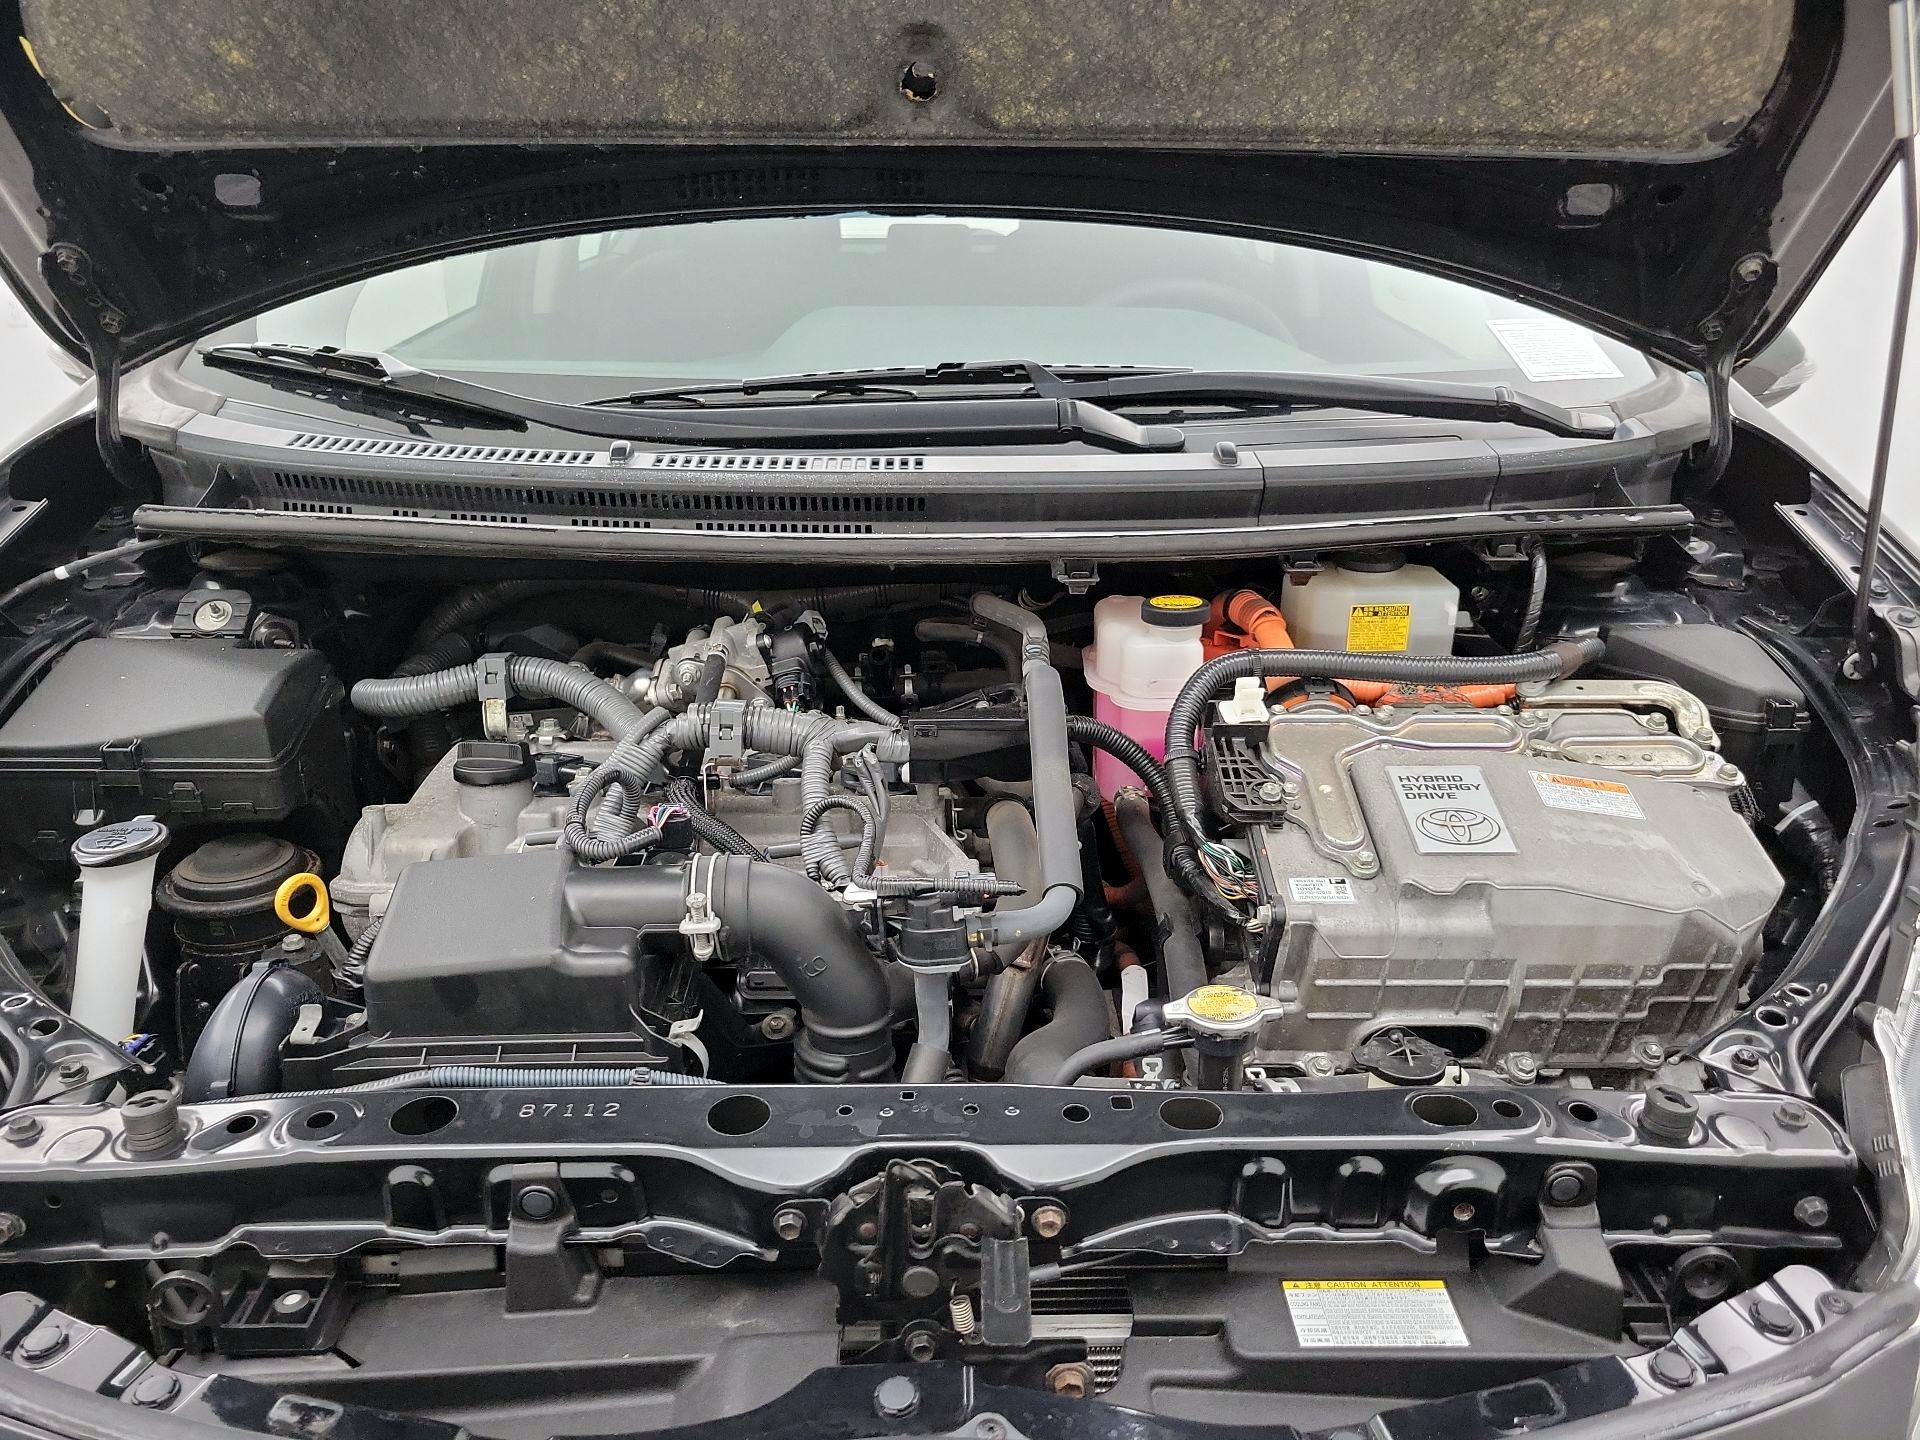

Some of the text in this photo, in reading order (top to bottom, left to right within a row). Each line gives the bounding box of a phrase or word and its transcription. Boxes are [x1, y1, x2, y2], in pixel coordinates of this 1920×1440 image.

[1401, 783, 1481, 791] SYNERGY
[519, 1102, 621, 1118] 87112
[1326, 1281, 1367, 1289] CAUTION
